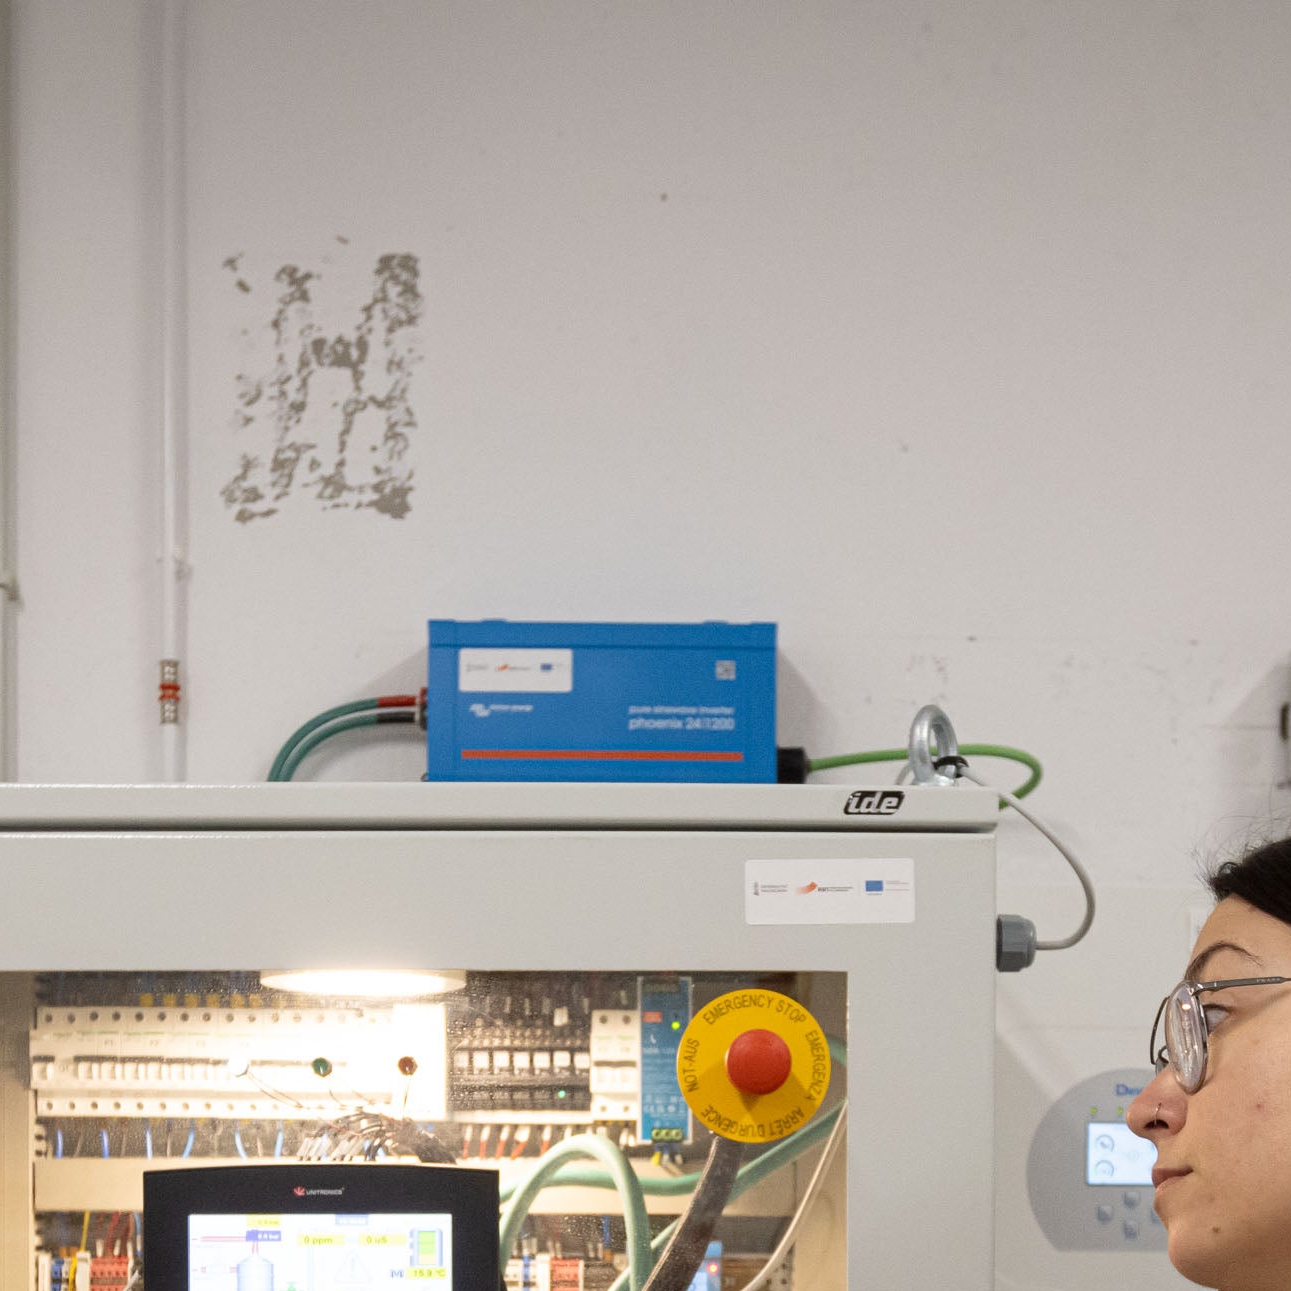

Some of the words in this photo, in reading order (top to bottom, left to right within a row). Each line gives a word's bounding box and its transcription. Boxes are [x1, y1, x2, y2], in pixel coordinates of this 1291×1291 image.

[848, 791, 899, 813] ide
[703, 994, 774, 1025] EMERGENCY
[775, 1000, 806, 1024] STOP
[683, 1038, 700, 1092] NOT-AUS
[805, 1029, 827, 1101] EMERGENZA
[312, 1237, 333, 1246] ppm
